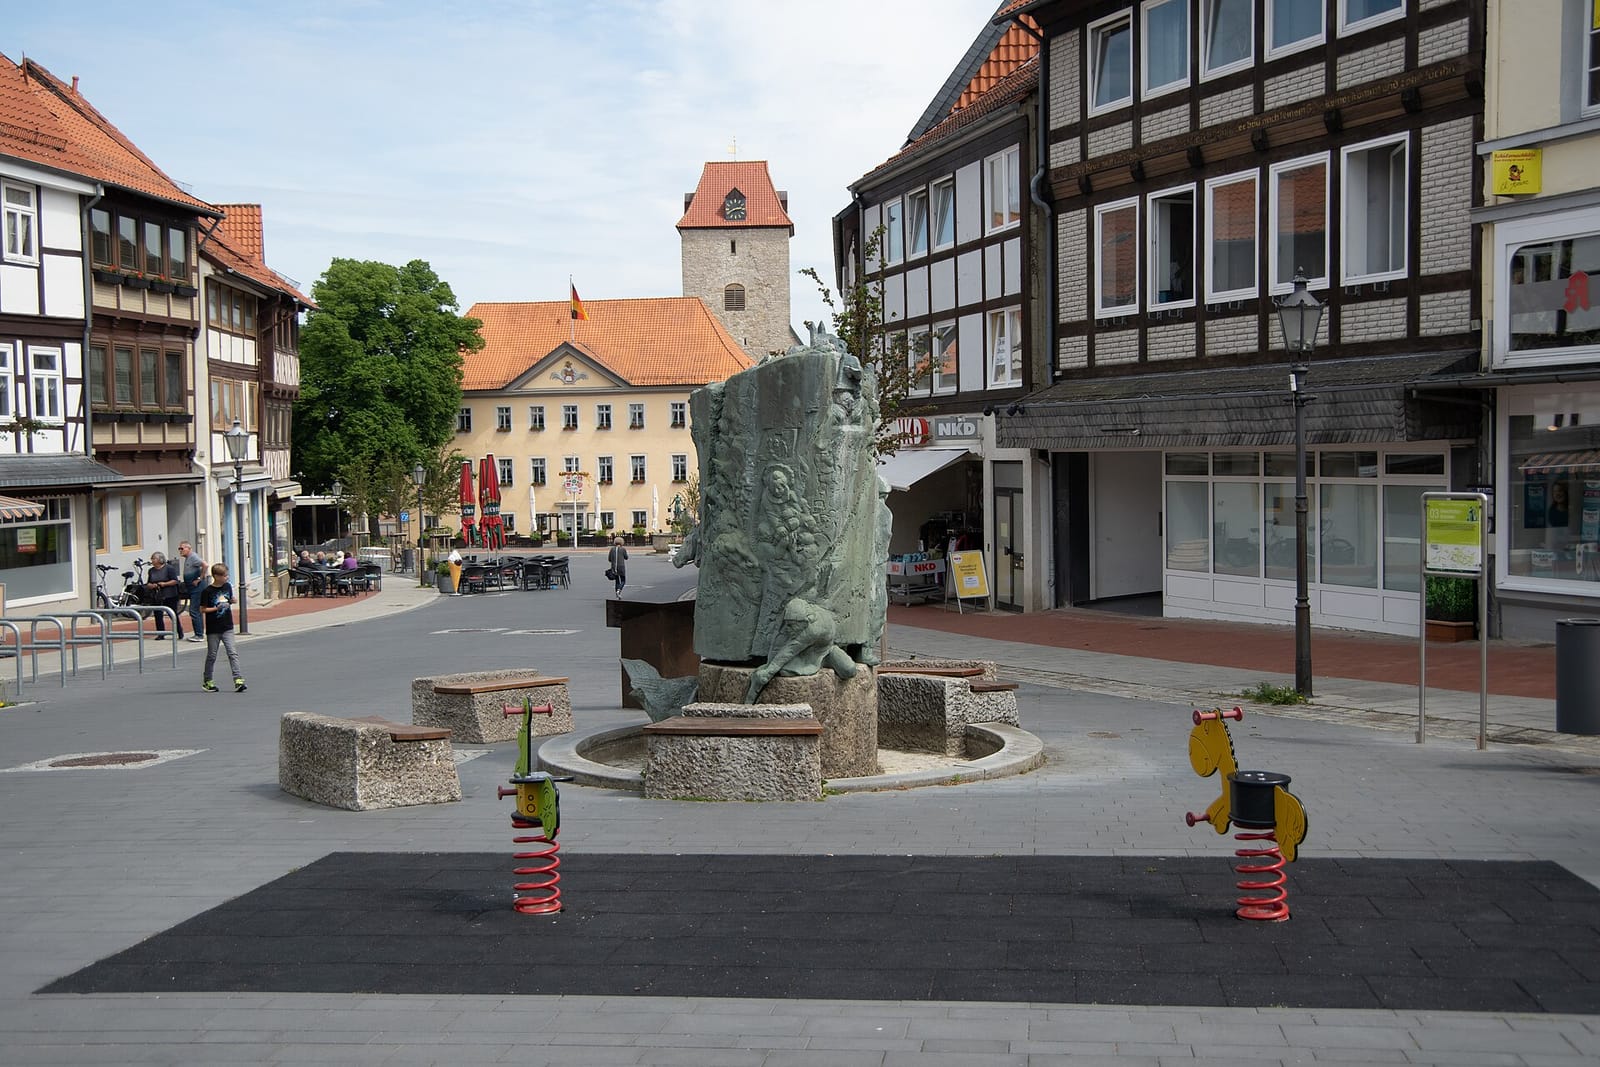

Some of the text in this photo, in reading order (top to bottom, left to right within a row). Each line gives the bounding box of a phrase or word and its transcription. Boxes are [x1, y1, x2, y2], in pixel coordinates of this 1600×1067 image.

[896, 418, 922, 445] NKD
[938, 422, 976, 436] NKD
[914, 563, 936, 572] NKD
